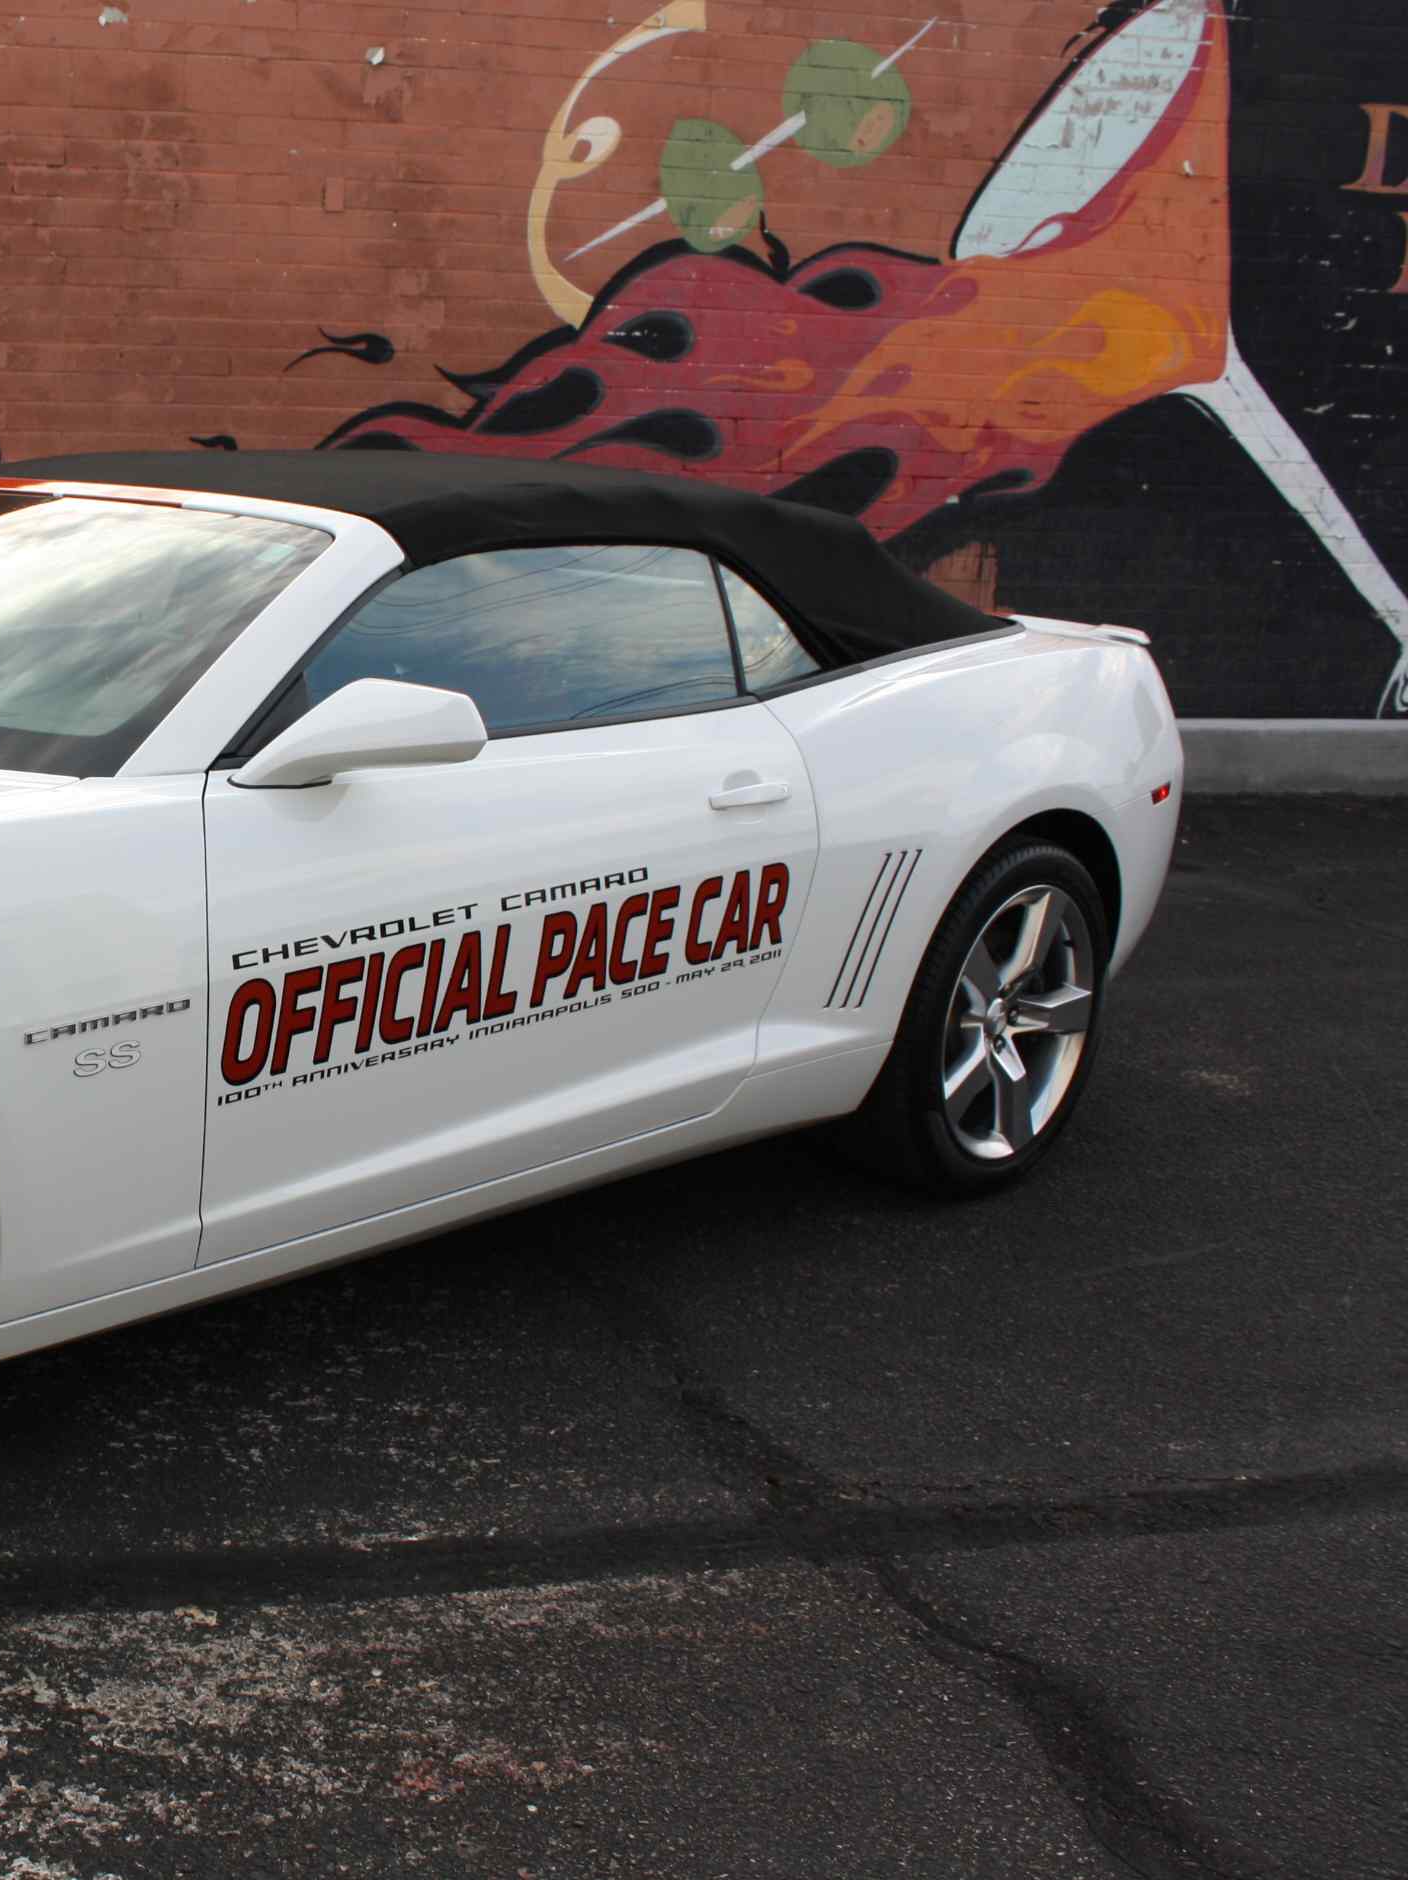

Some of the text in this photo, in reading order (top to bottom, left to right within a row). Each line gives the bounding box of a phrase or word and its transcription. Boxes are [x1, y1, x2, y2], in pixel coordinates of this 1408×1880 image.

[232, 866, 649, 970] CHEVROLET CAMARO
[24, 998, 191, 1045] CAMARO
[220, 862, 790, 1086] OFFICIAL PACE CAR
[292, 1034, 460, 1087] ANNIVERSARY
[468, 994, 612, 1040] INDIANAPOLIS
[620, 980, 660, 1000] 500
[675, 965, 716, 985] MAY
[749, 949, 782, 966] 2011
[73, 1040, 141, 1077] SS
